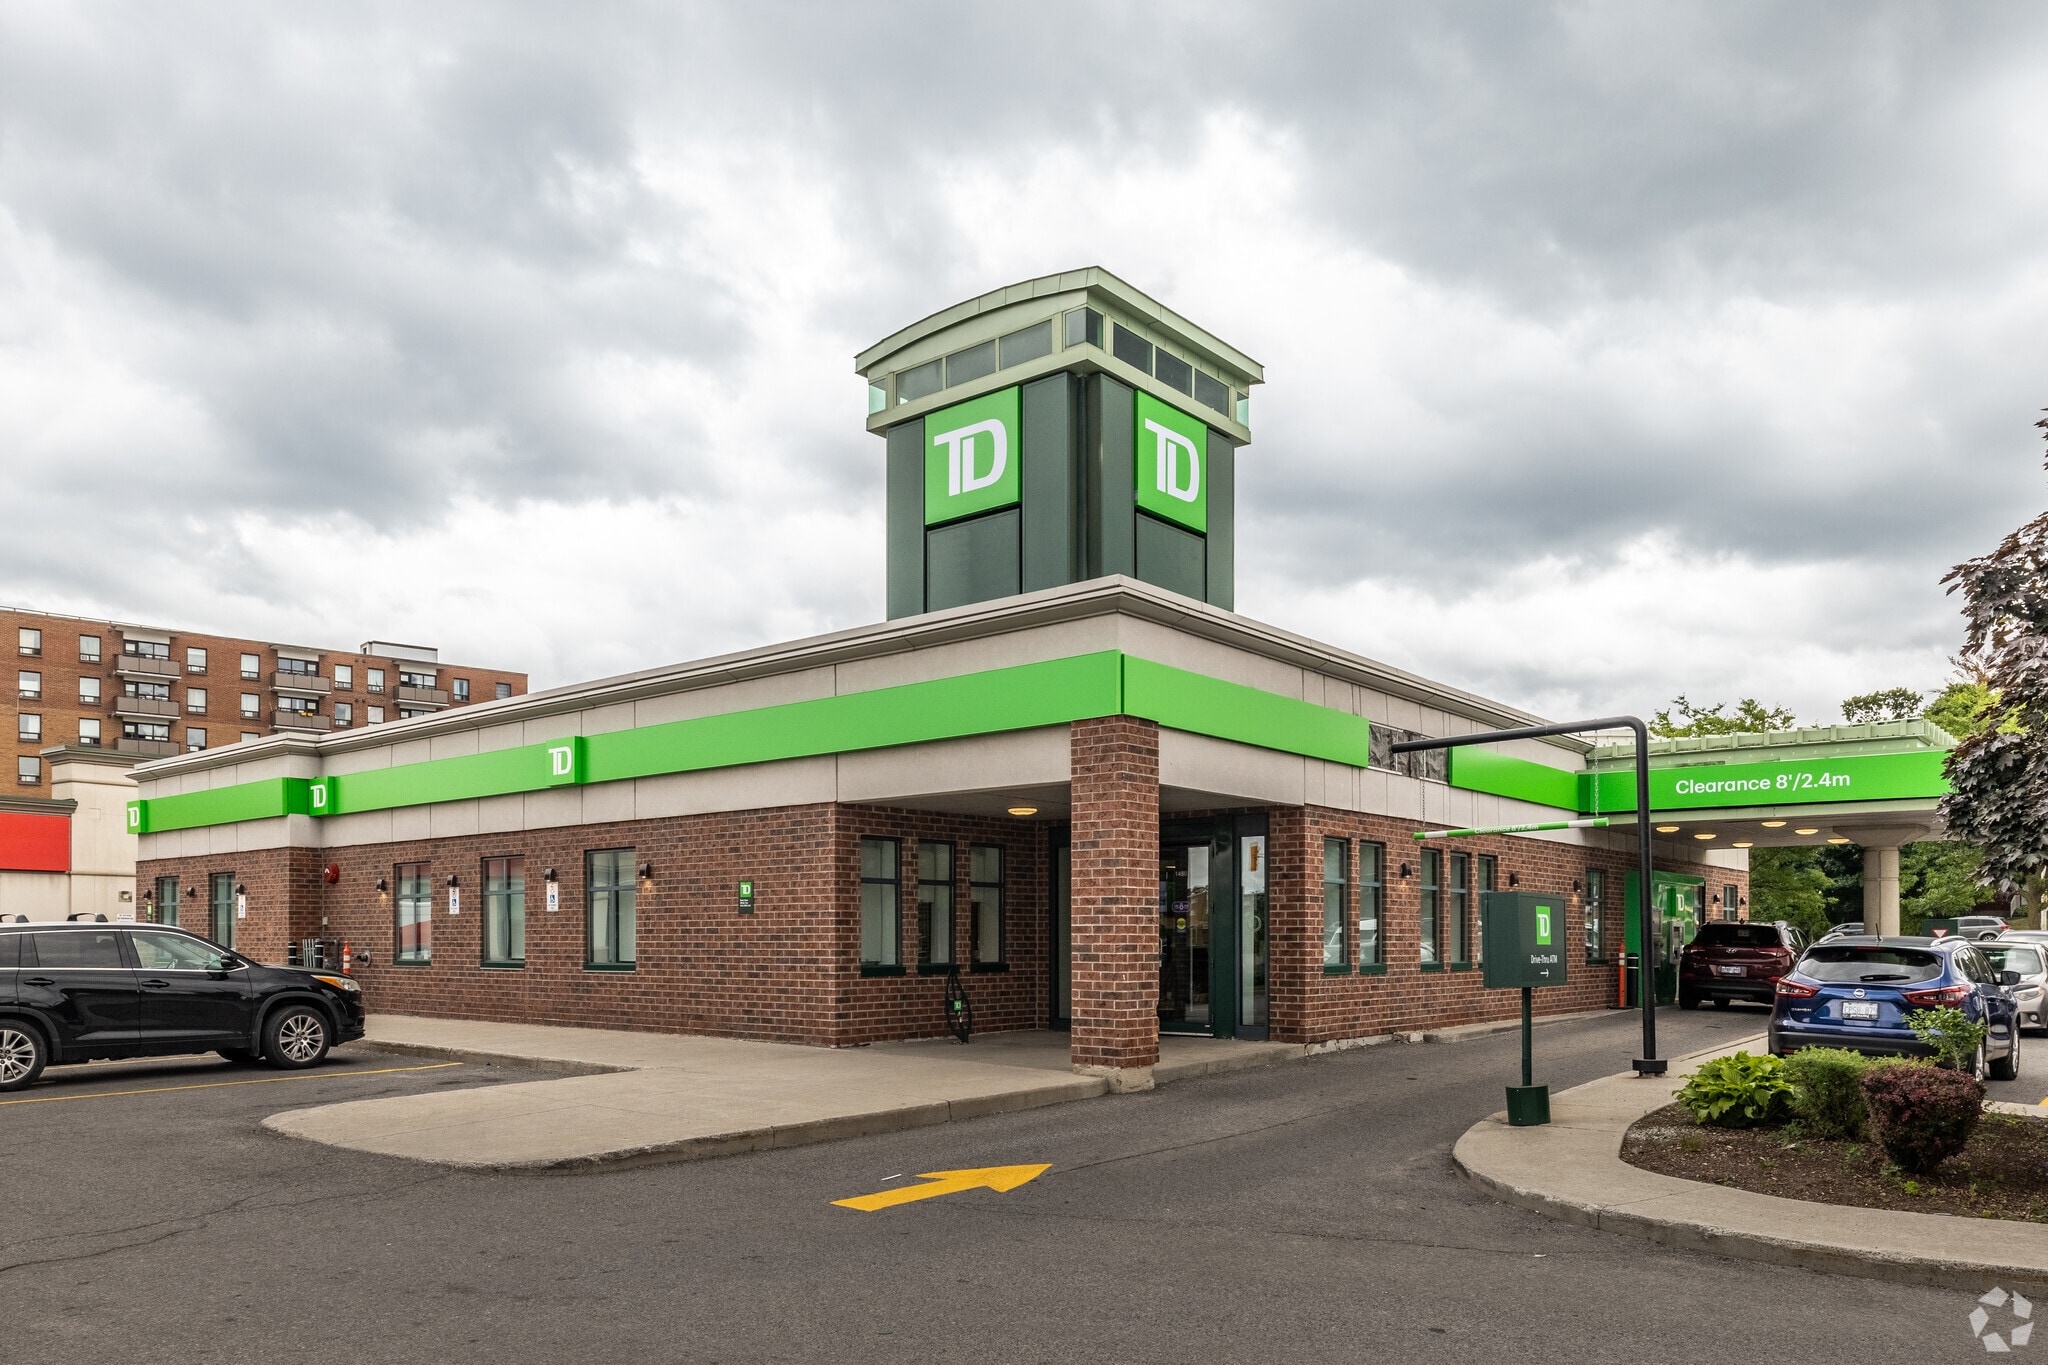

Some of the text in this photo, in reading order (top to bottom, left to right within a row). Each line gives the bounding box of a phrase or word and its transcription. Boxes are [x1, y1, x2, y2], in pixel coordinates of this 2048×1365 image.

[933, 418, 1008, 496] TD
[1144, 418, 1200, 503] TD
[548, 746, 572, 776] TD
[1675, 772, 1851, 795] Clearance 8'/2.4m
[310, 784, 327, 808] TD
[127, 806, 140, 827] TD
[1474, 825, 1511, 834] Clearance
[740, 884, 751, 895] TD
[1676, 893, 1685, 911] TD
[1537, 913, 1550, 937] TD
